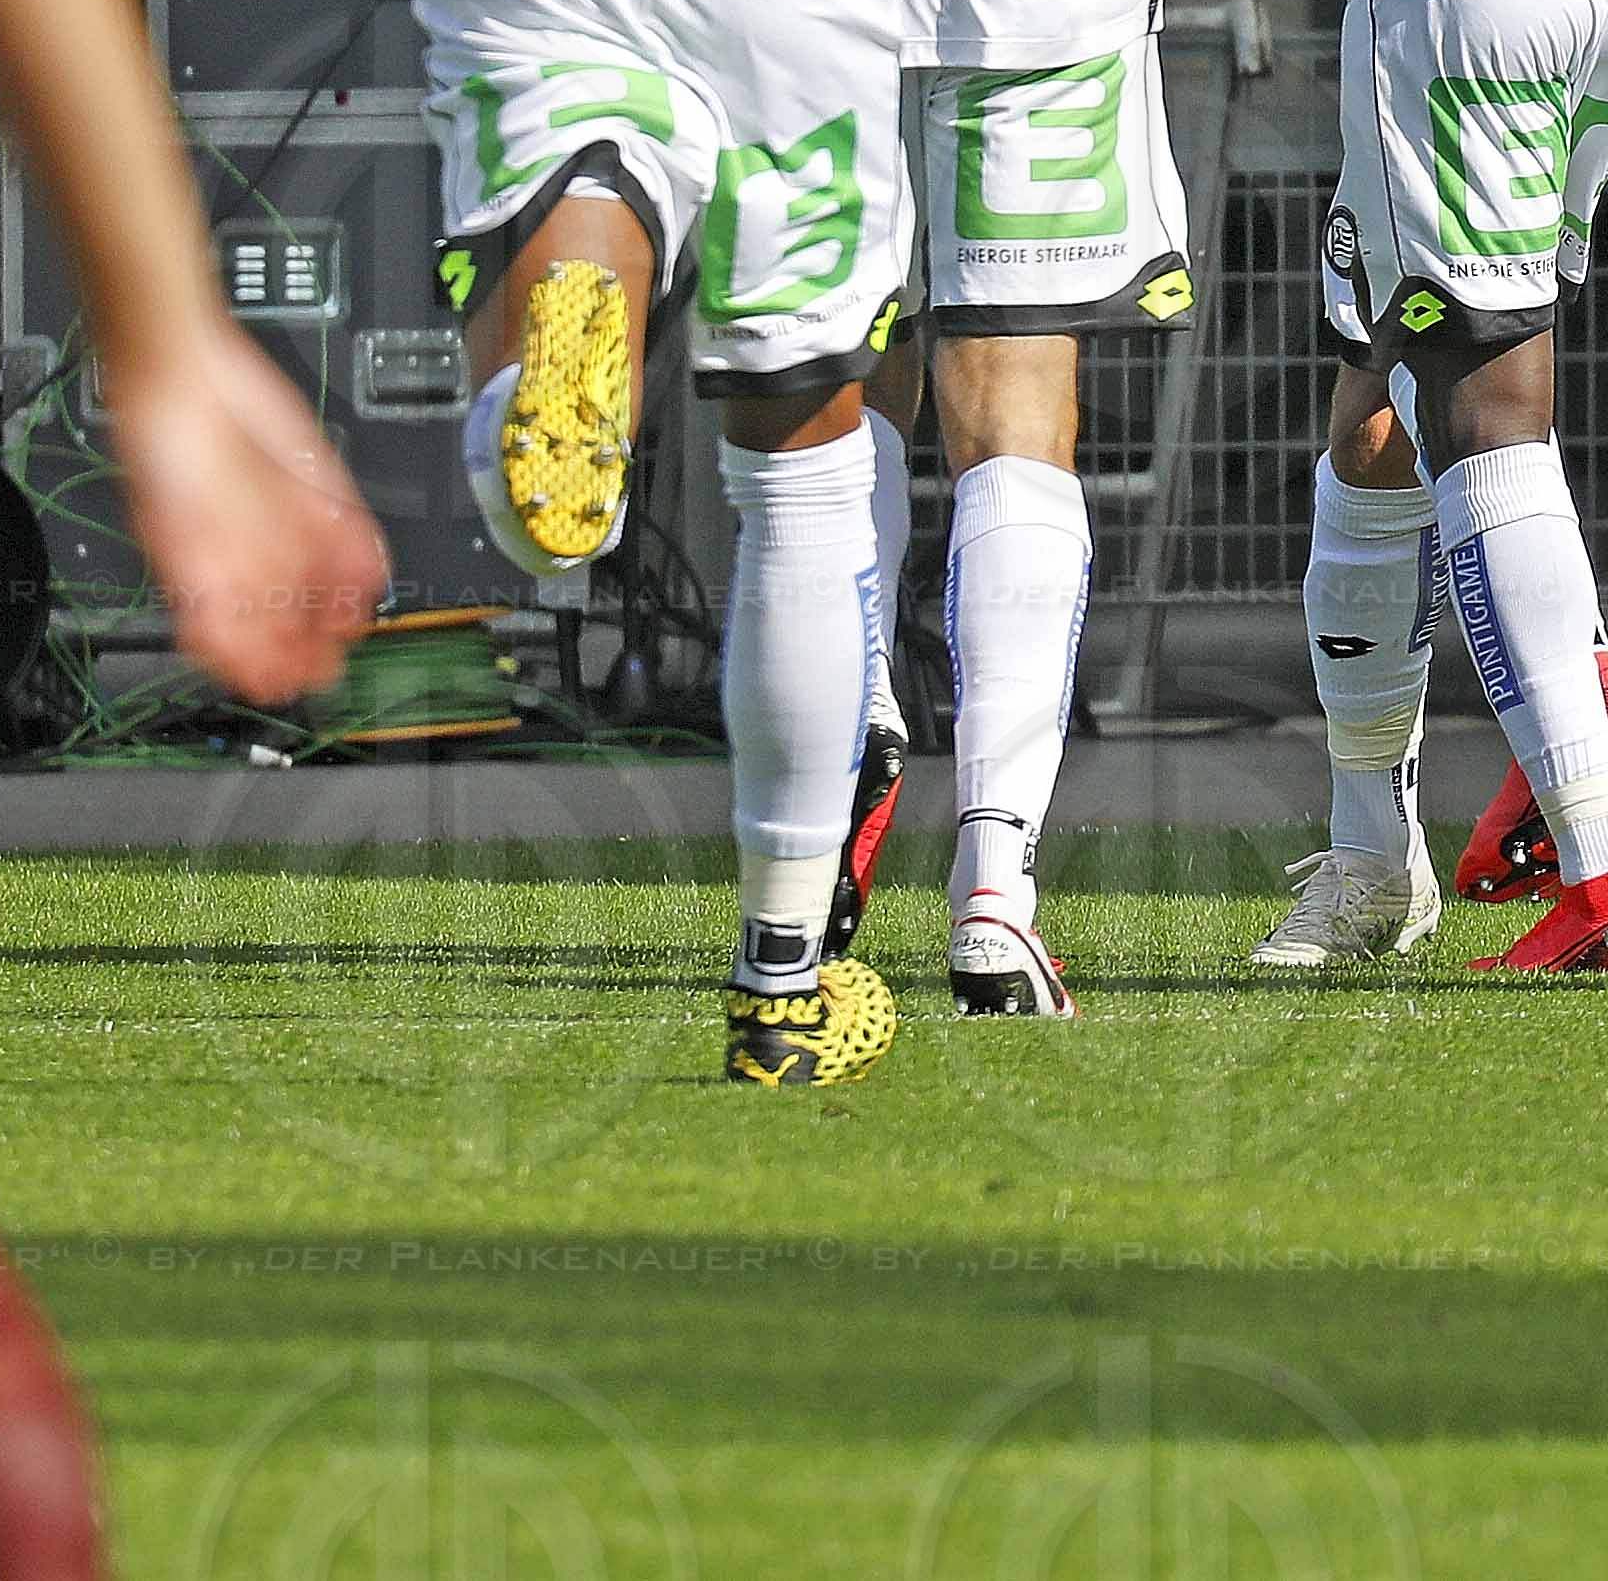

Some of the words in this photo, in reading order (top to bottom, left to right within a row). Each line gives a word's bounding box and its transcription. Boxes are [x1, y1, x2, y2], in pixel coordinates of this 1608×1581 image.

[957, 248, 1028, 265] ENERGIE
[1034, 242, 1129, 263] STEIERMARK
[1454, 538, 1515, 703] PUNTIGAME
